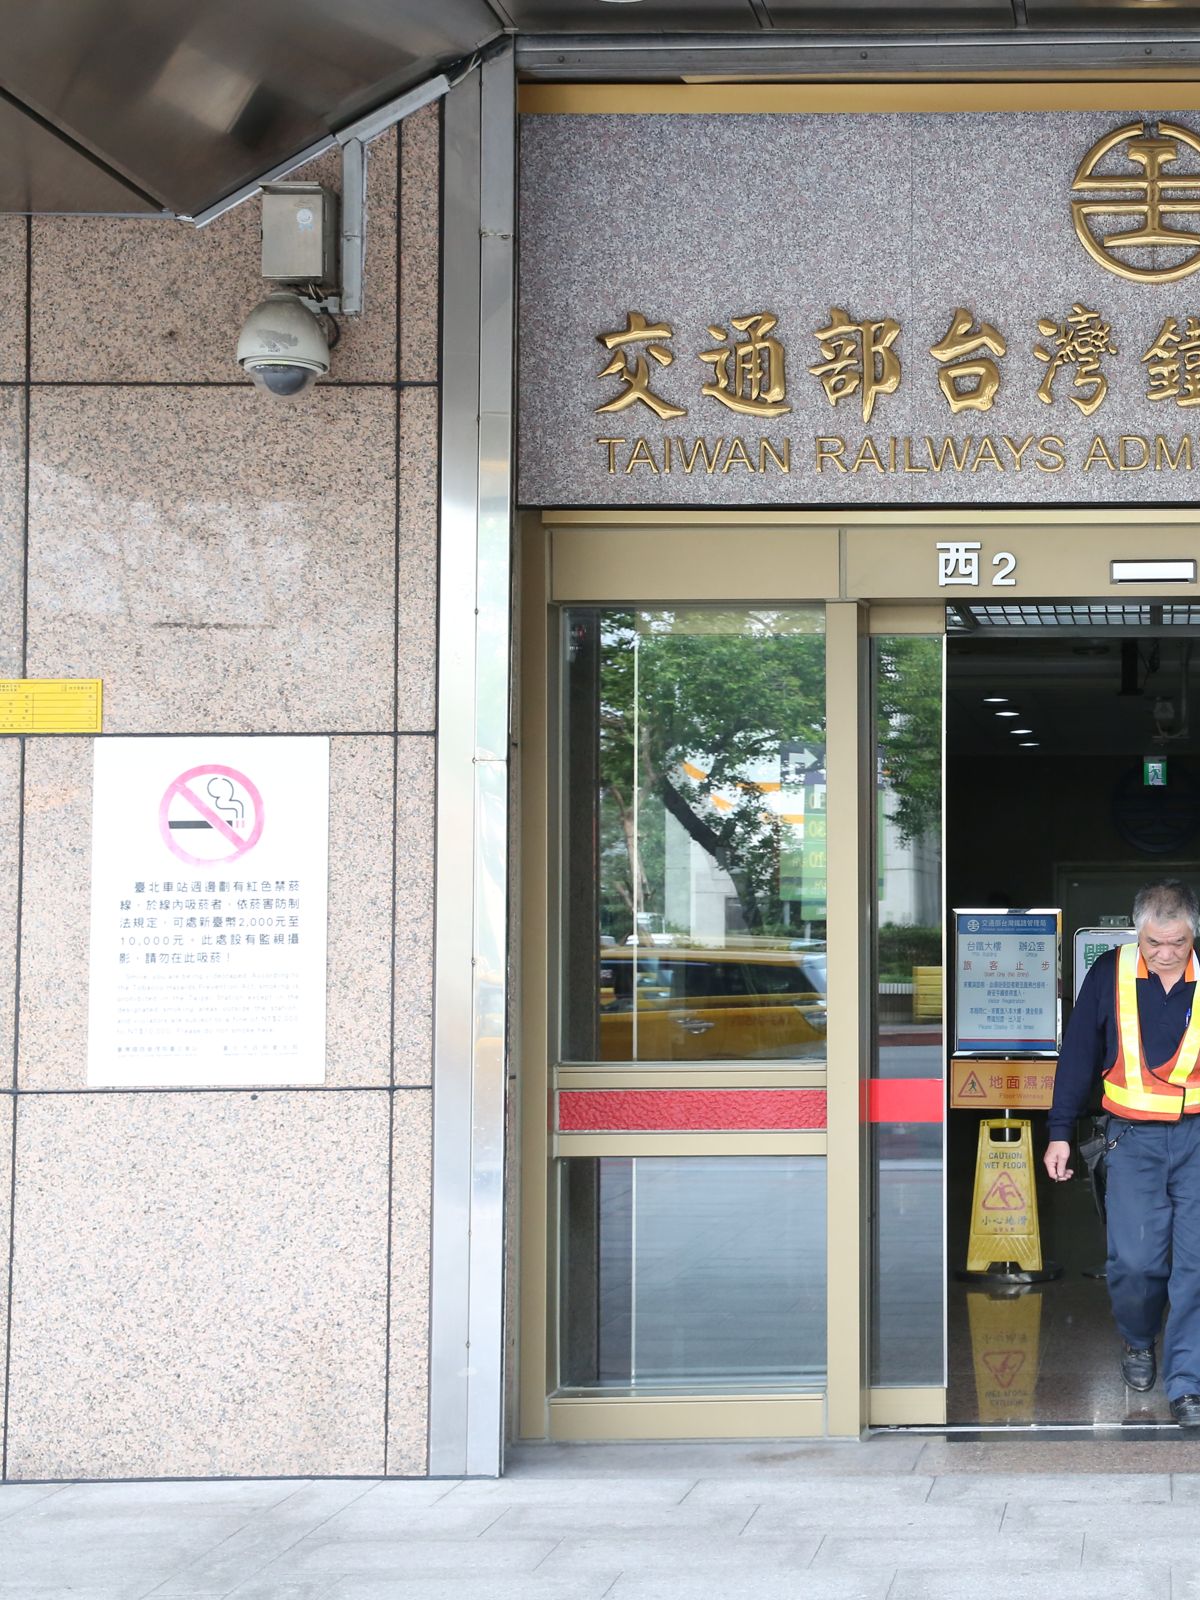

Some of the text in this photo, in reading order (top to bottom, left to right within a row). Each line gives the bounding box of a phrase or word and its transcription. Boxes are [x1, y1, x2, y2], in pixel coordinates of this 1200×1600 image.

[597, 436, 791, 474] TAIWAN
[815, 435, 1065, 474] RAILWAYS
[936, 541, 1017, 587] 西 2
[989, 1152, 1022, 1160] CAUTION
